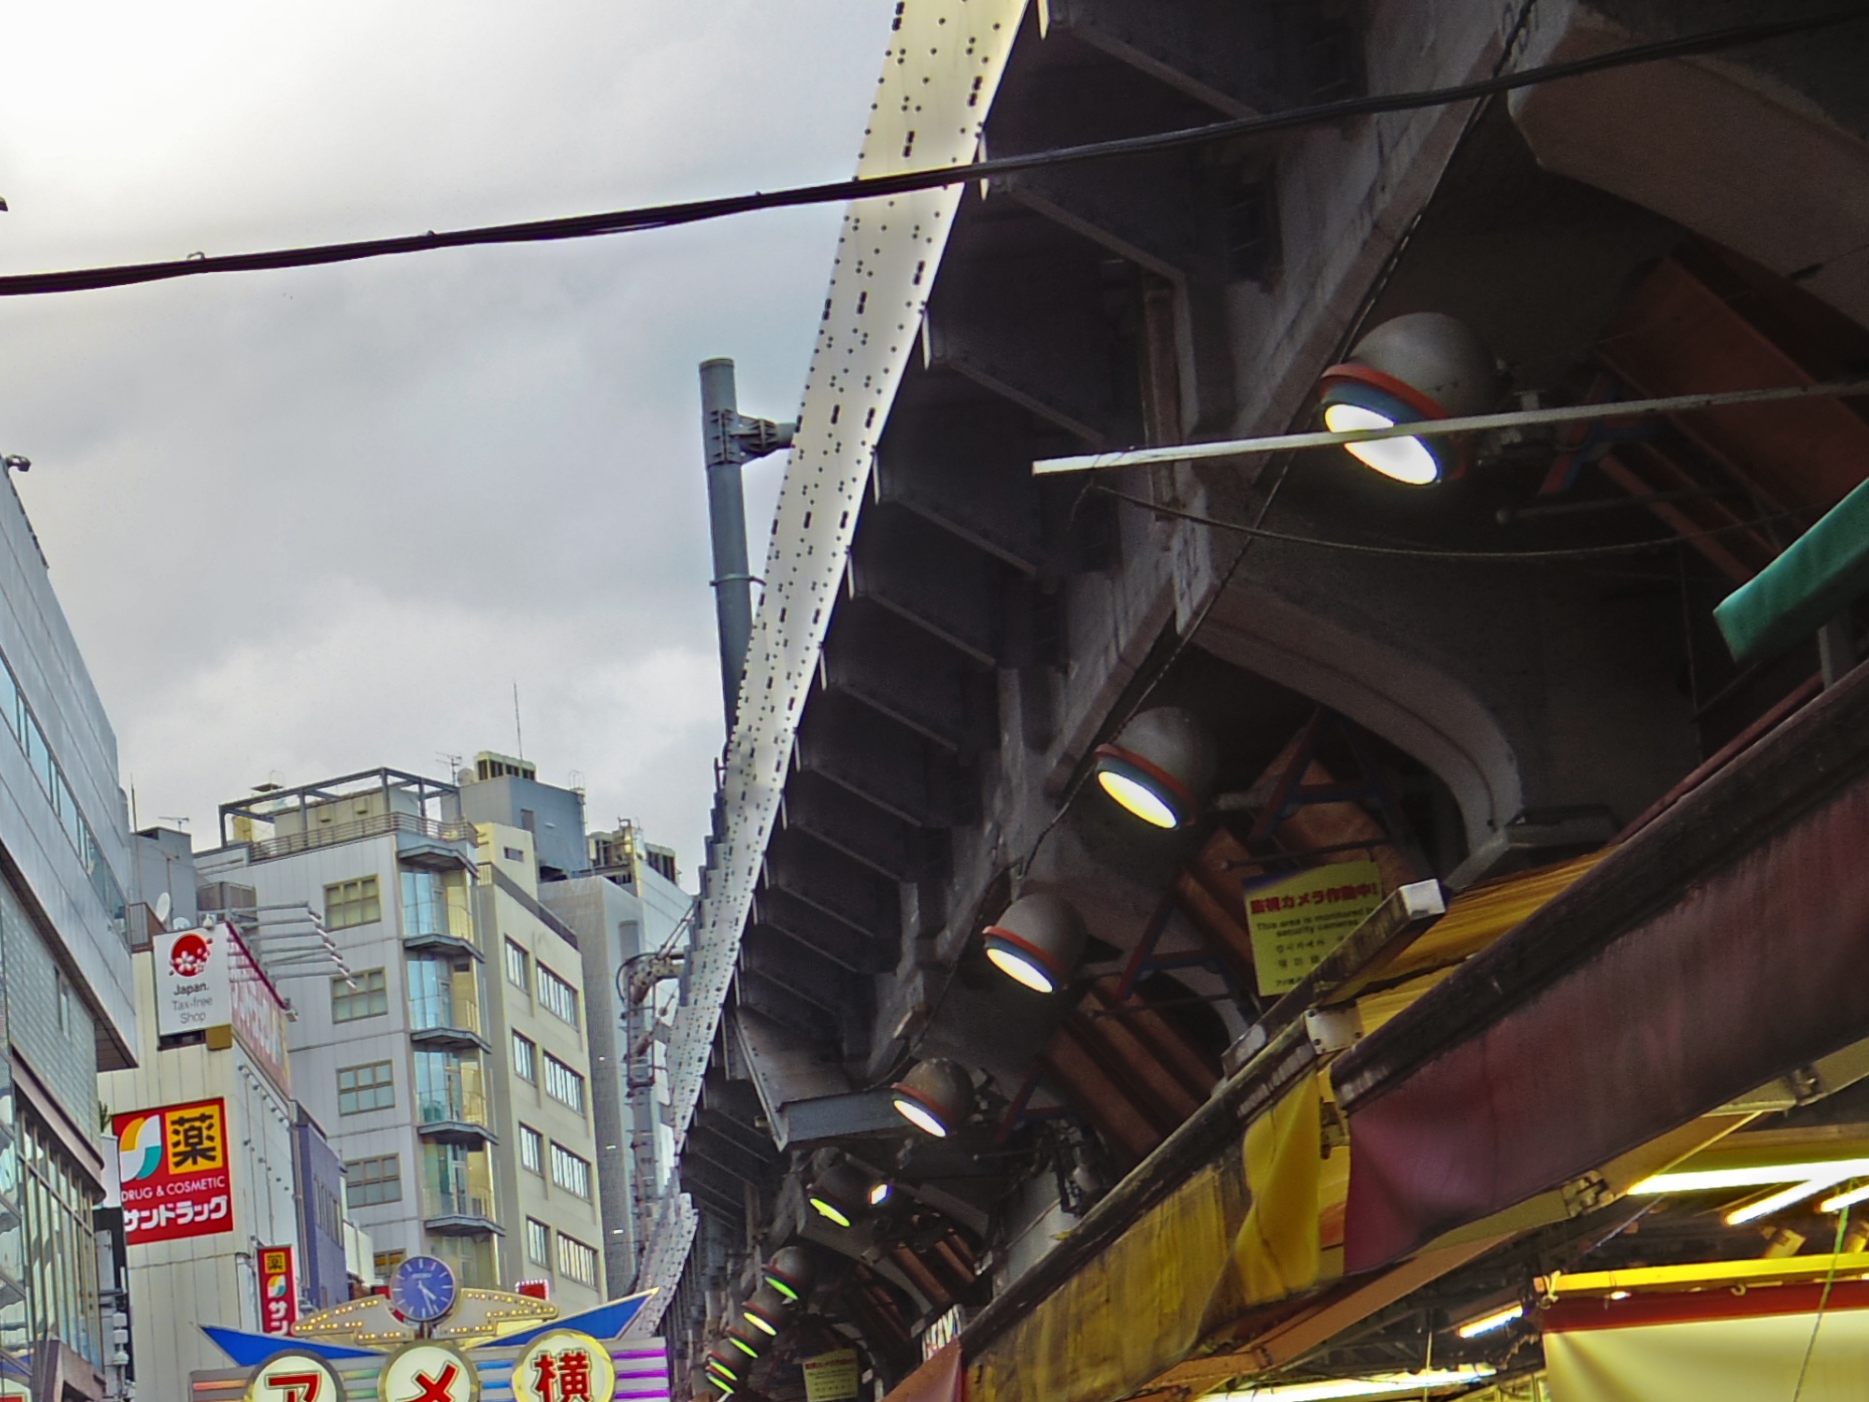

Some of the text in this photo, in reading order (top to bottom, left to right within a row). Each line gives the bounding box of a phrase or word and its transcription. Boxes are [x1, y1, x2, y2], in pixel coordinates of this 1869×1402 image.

[172, 996, 213, 1011] Tax-free
[180, 1012, 206, 1024] Shop
[171, 1113, 217, 1168] 薬
[121, 1175, 226, 1202] DRUG & COSMETIC
[123, 1195, 228, 1232] サンドラッグ
[266, 1254, 283, 1270] 薬
